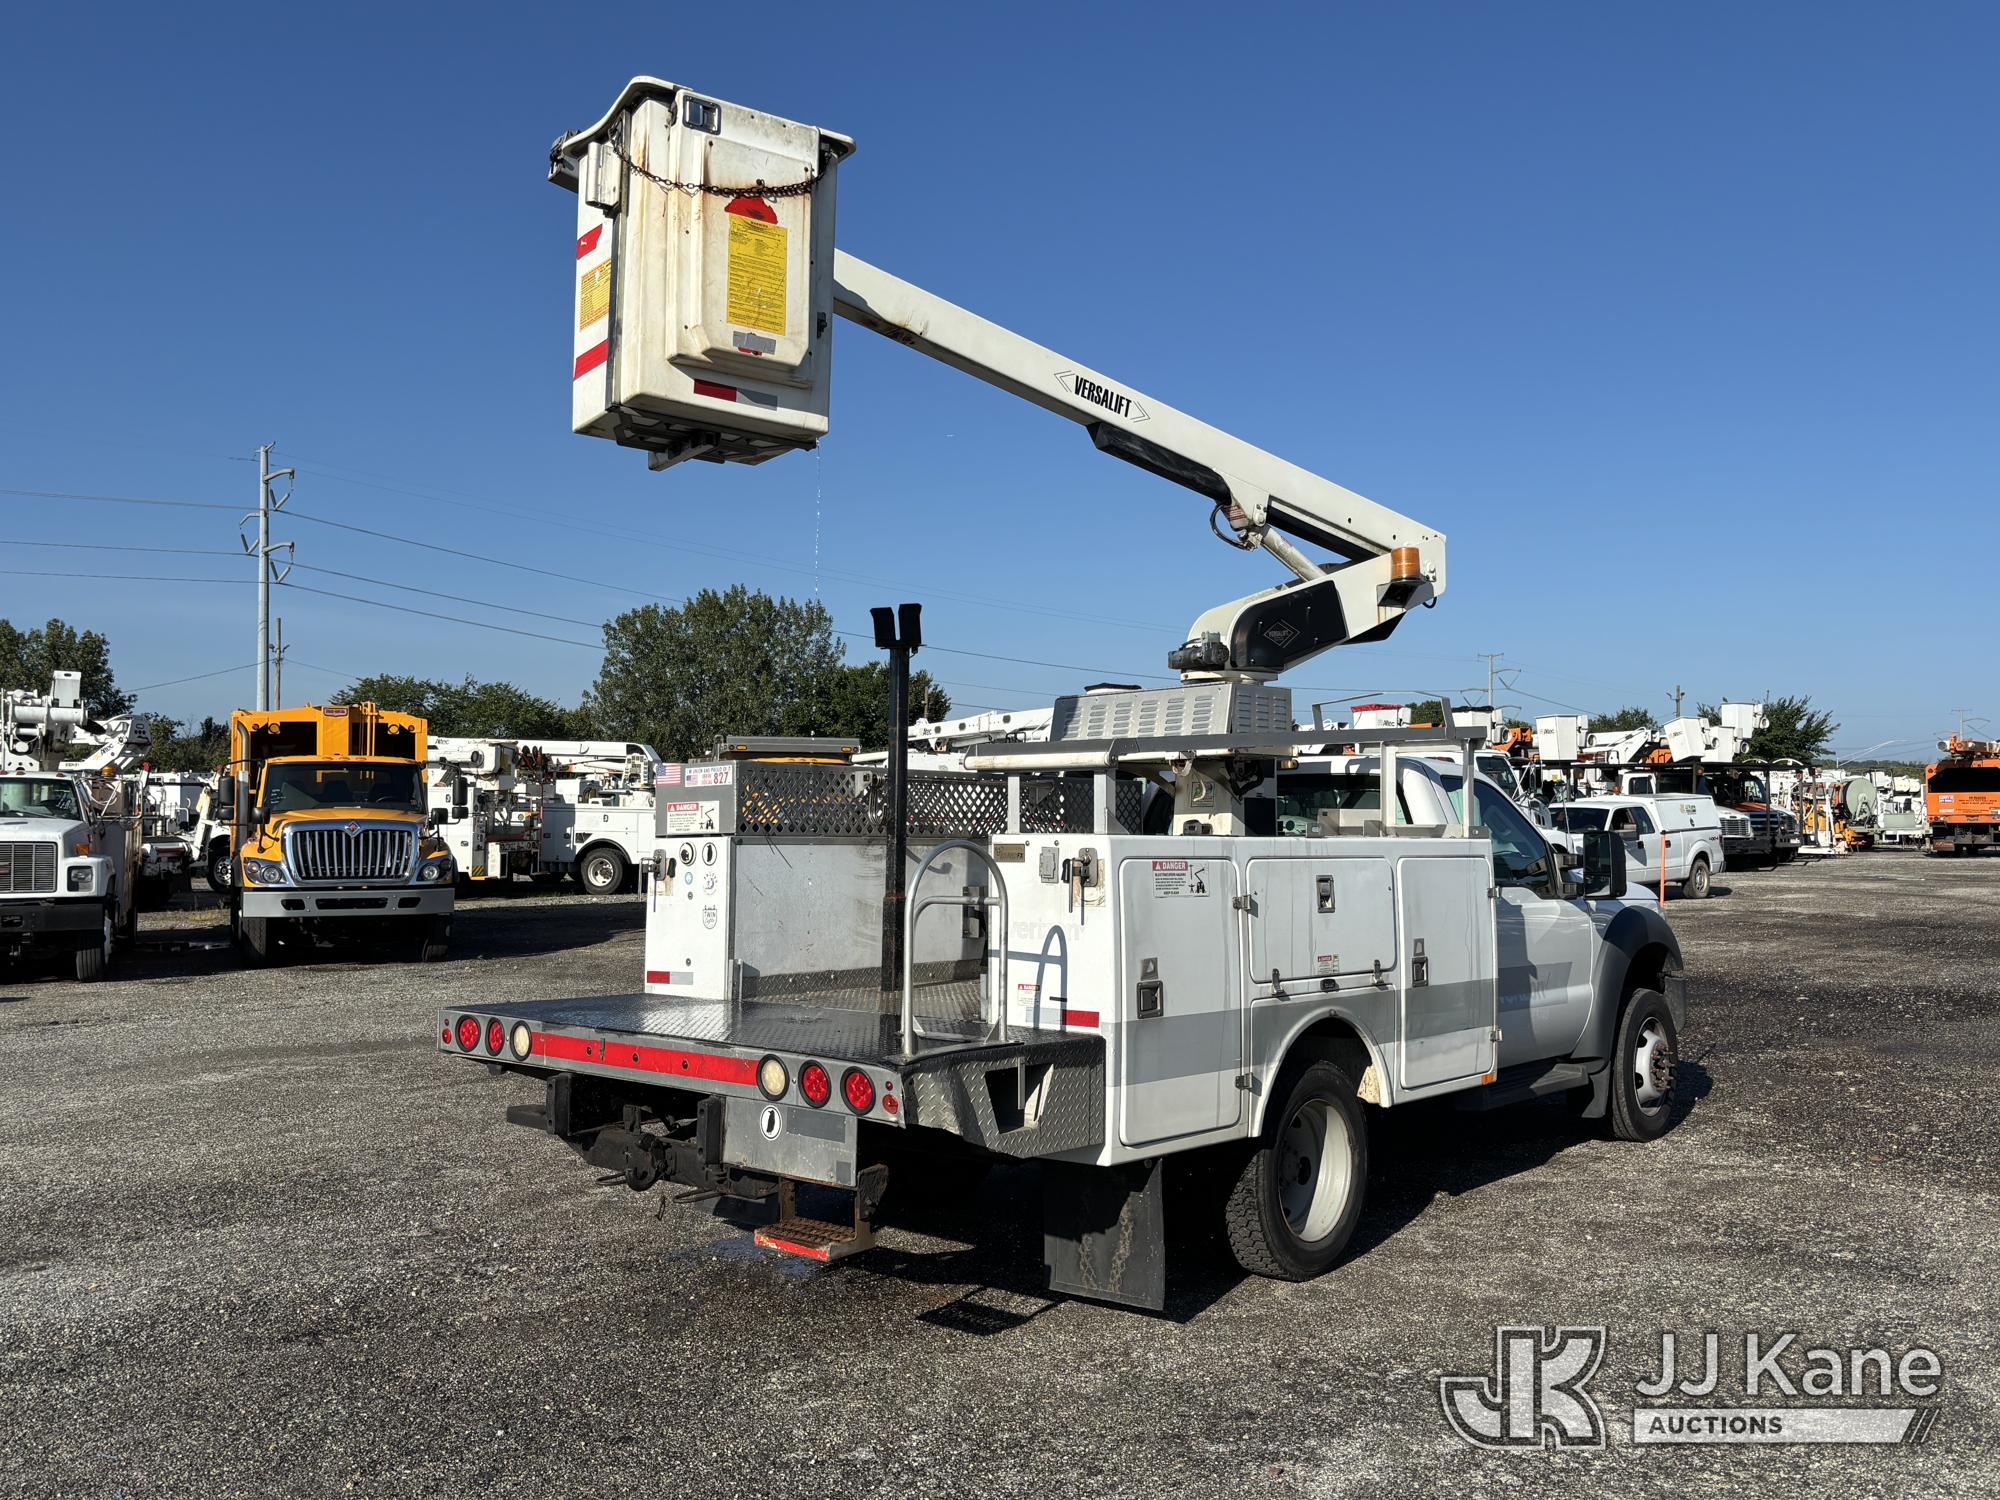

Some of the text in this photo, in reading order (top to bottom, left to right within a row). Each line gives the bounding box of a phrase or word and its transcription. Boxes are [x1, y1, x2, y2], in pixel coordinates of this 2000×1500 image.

[1074, 375, 1132, 418] VERSALIFT
[713, 771, 729, 785] 827
[676, 803, 698, 811] DANGER
[1162, 861, 1186, 870] DANGER
